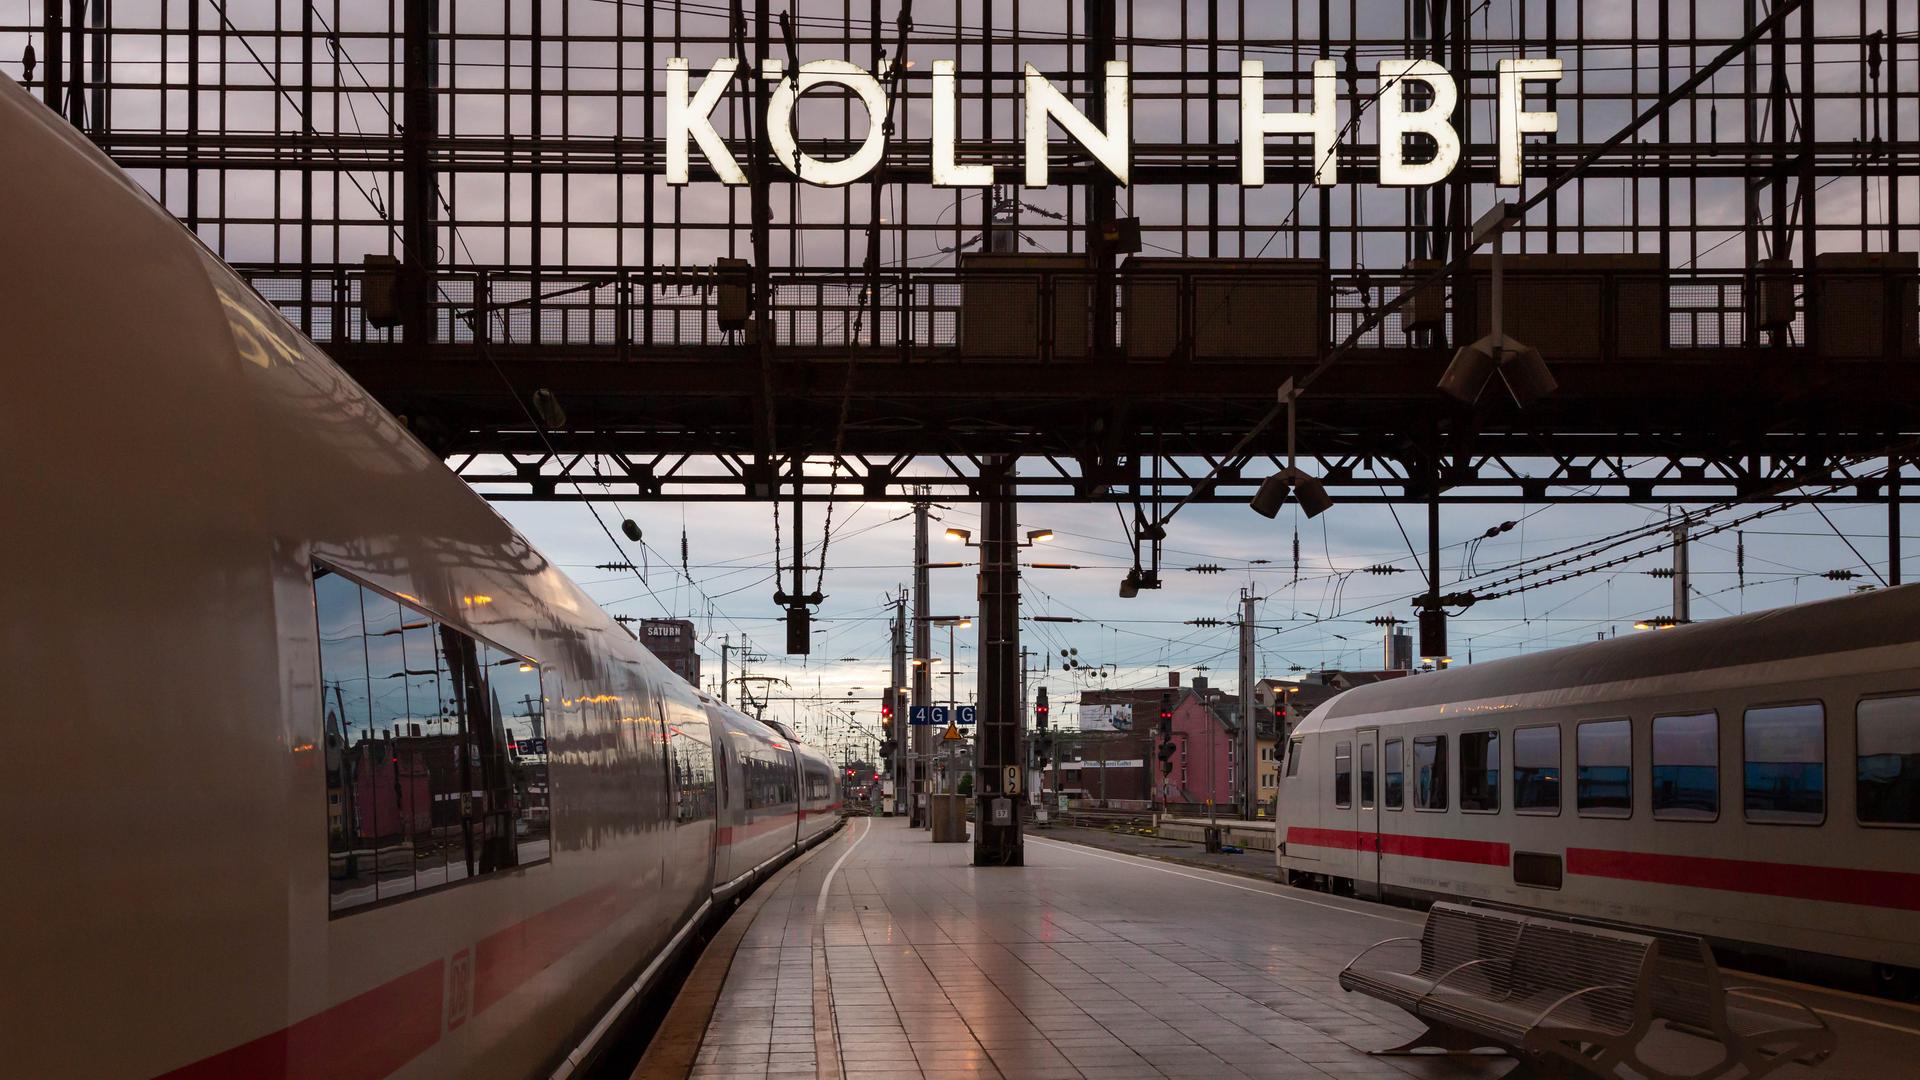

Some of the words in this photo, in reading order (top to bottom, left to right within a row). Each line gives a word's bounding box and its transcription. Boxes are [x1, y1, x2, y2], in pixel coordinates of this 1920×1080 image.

[666, 57, 1128, 186] KÖLN
[1241, 58, 1562, 187] HBF
[647, 627, 680, 636] SATURN
[916, 708, 926, 722] 4
[931, 707, 943, 722] G
[961, 707, 973, 722] G
[1008, 767, 1016, 779] 0
[1008, 782, 1016, 794] 2
